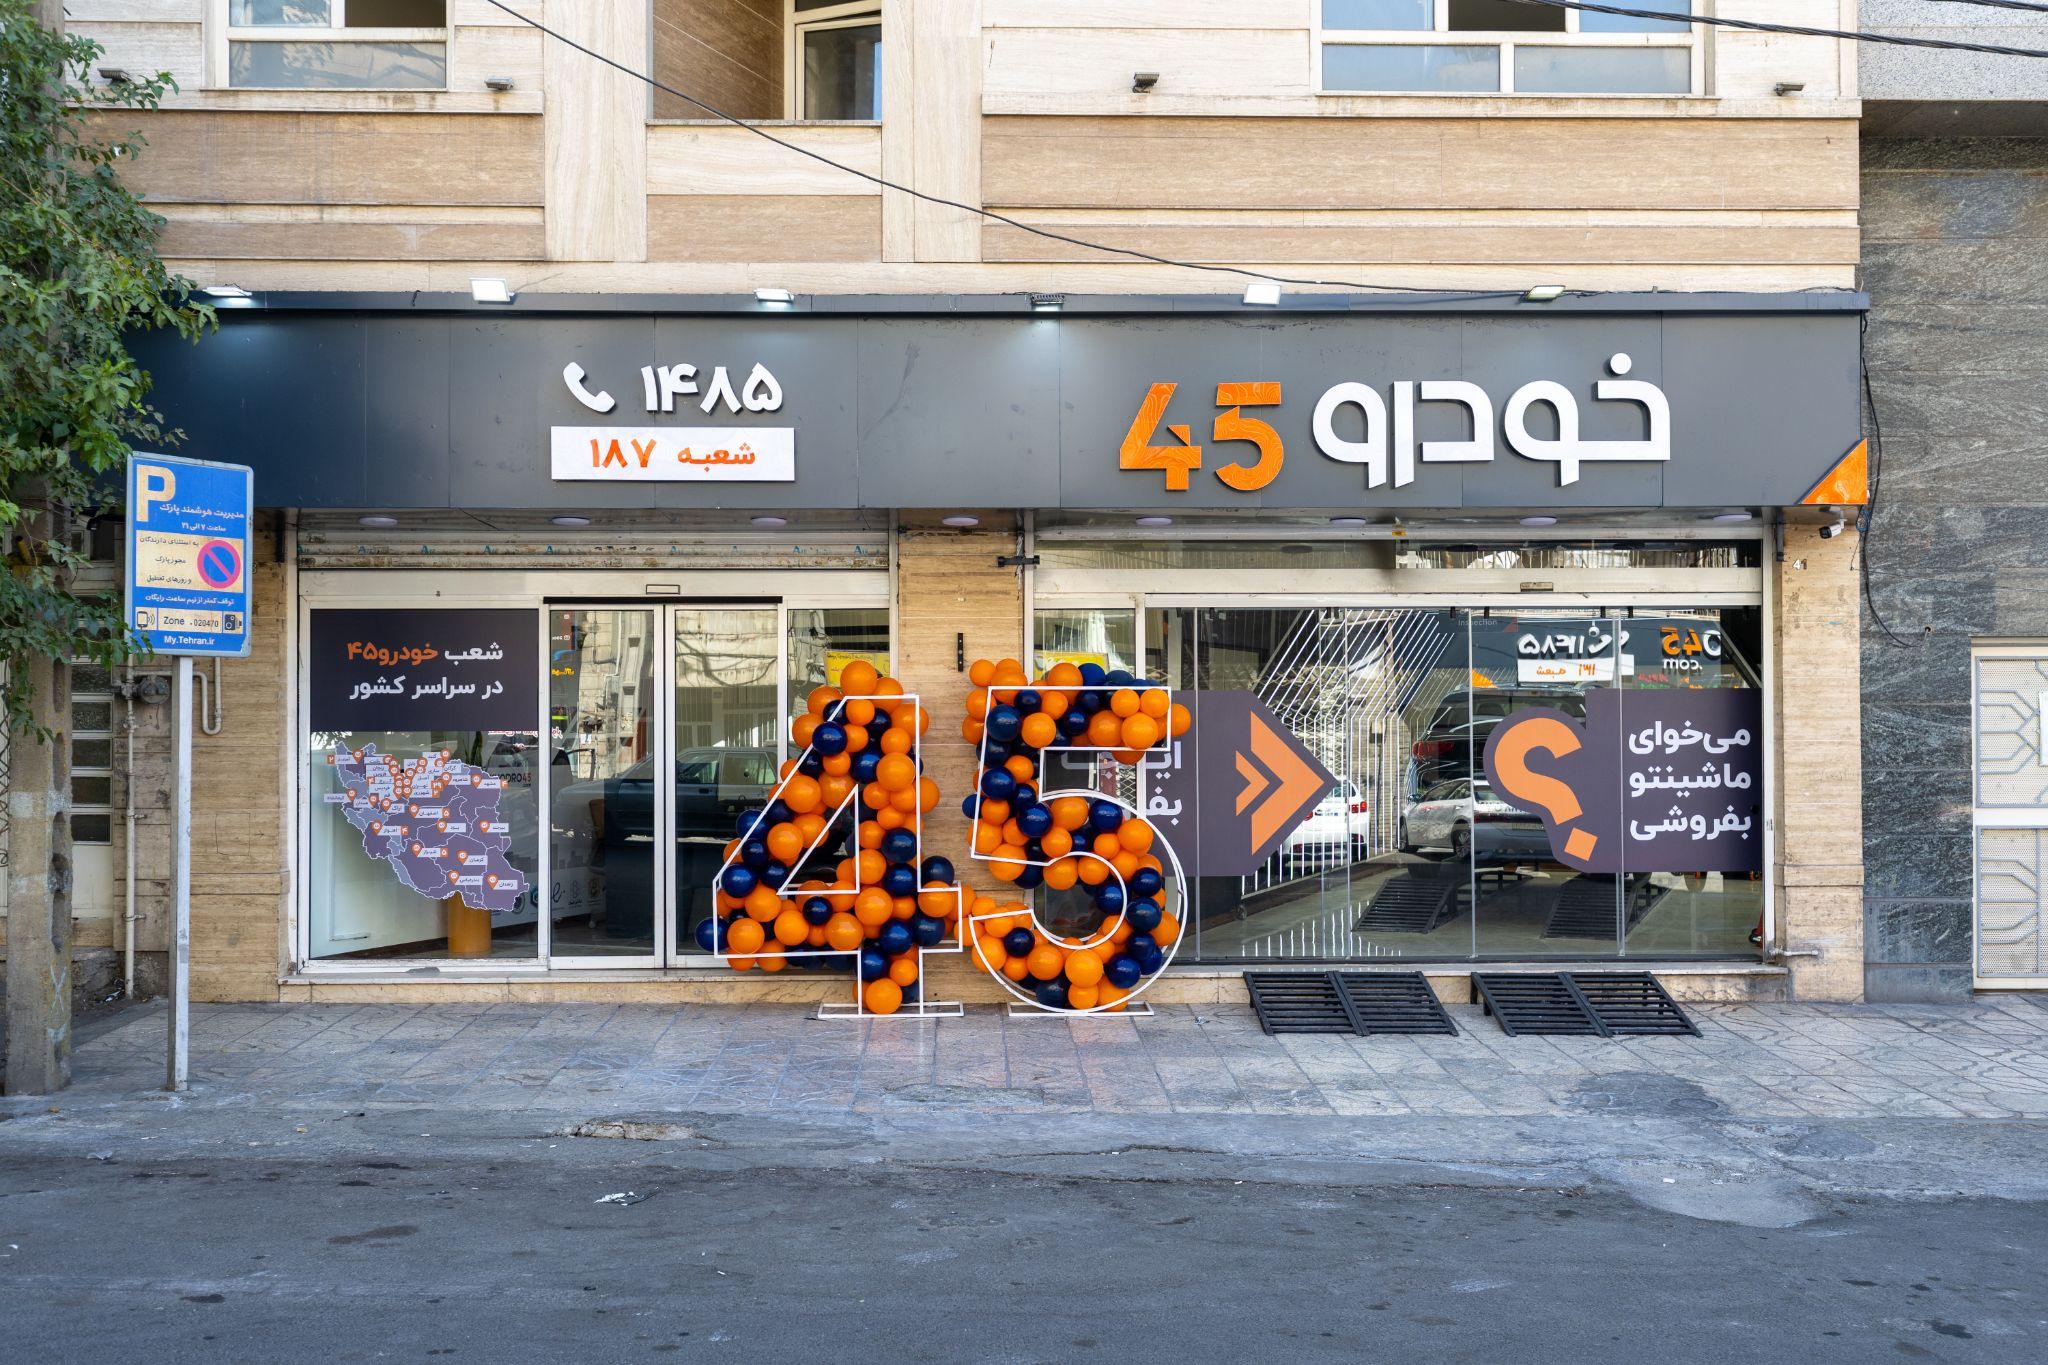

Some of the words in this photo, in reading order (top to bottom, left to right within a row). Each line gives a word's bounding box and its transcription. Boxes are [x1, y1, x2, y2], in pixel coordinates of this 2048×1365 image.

[640, 362, 783, 414] ۱۴۸۵
[1312, 352, 1671, 488] خودرو
[1119, 381, 1285, 491] 45
[590, 438, 657, 468] ۱۸۷
[678, 442, 755, 472] شعبه
[136, 464, 176, 522] P
[160, 503, 180, 515] پارک
[181, 505, 212, 518] هوشمند
[214, 510, 244, 519] مدیریت
[190, 523, 200, 531] الی
[140, 536, 166, 545] دارندگان
[145, 593, 165, 602] رایگان
[217, 598, 234, 606] توقف
[163, 616, 185, 625] Zone
[1458, 619, 1498, 627] Insection
[164, 635, 215, 645] My.Tehran.ir
[444, 641, 503, 666] شعب
[349, 675, 406, 700] کشور
[411, 677, 476, 700] سراسر
[482, 680, 503, 700] در
[1629, 761, 1751, 798] ماشینتو
[1630, 805, 1752, 840] بفروشی
